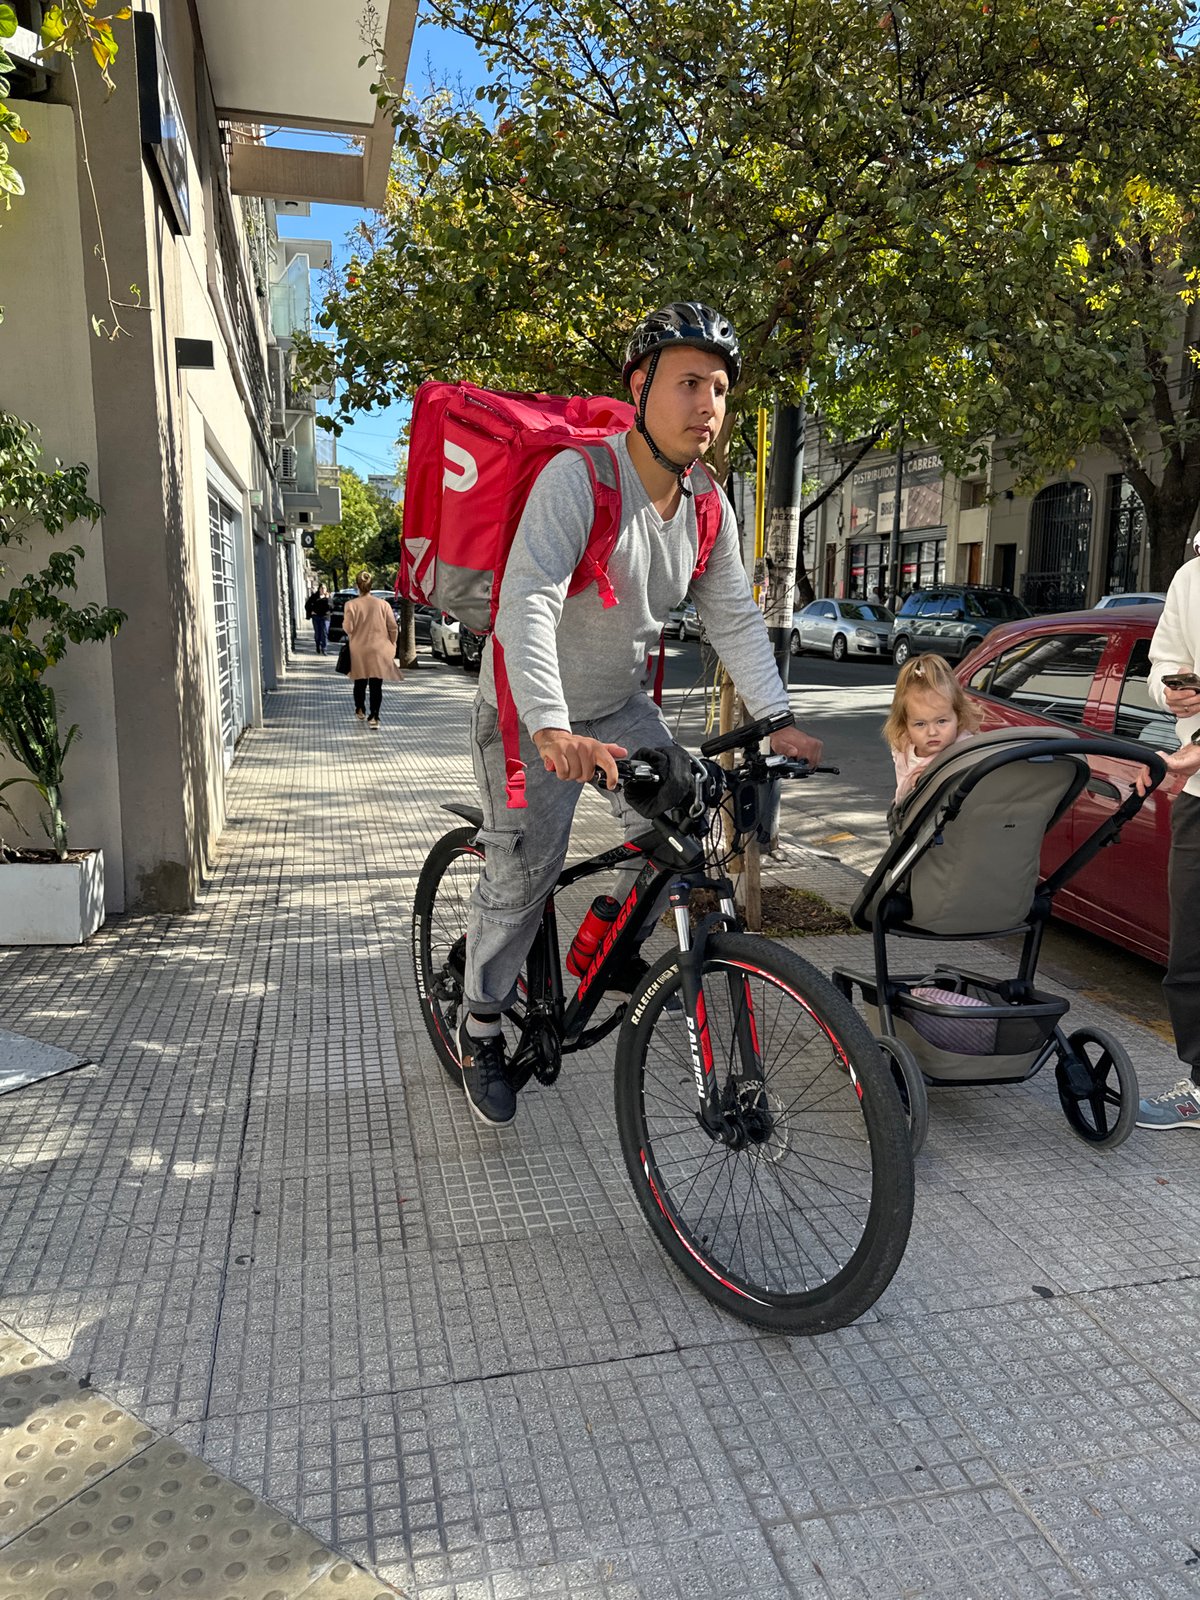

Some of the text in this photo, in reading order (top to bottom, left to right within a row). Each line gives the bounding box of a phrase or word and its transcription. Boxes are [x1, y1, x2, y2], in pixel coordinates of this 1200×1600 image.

[853, 463, 905, 485] DISTRIBUIDO
[578, 885, 639, 1003] RALEIGH
[416, 958, 427, 999] RALEIGH
[631, 981, 661, 1025] RALEIGH
[686, 1016, 706, 1099] RALEIGH
